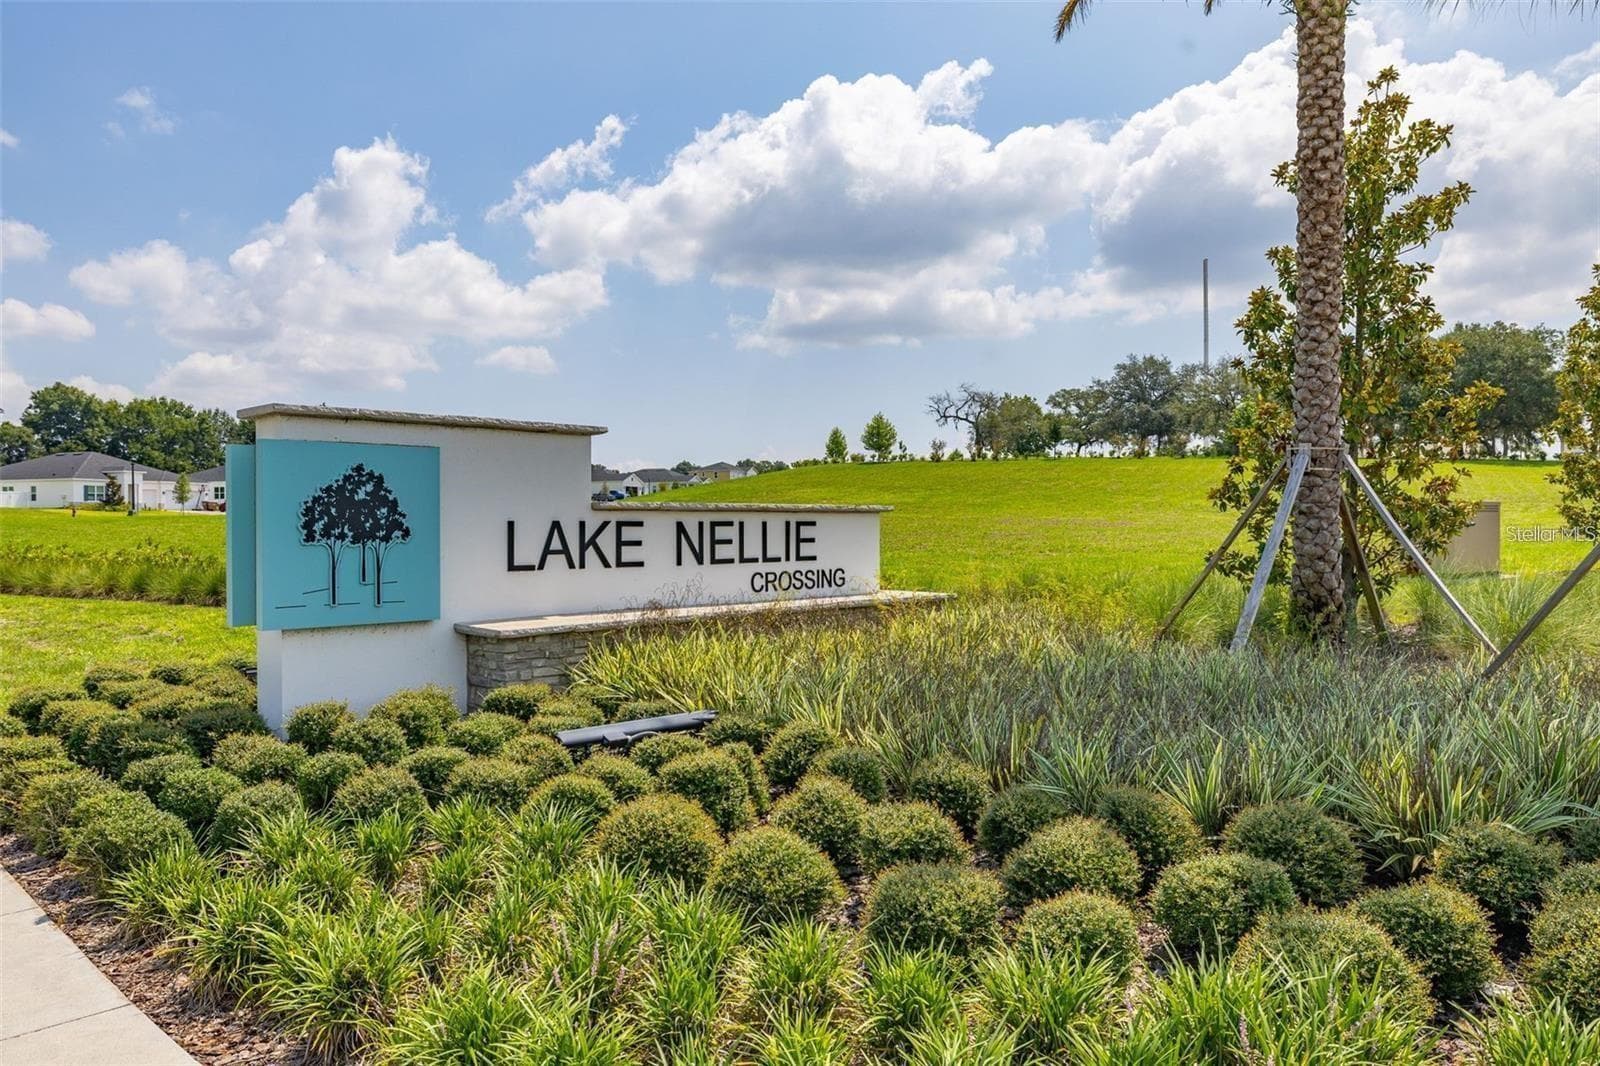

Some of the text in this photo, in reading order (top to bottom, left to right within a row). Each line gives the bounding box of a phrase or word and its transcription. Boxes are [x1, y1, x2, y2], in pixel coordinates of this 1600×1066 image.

[507, 520, 818, 571] LAKE NELLIE
[751, 568, 846, 593] CROSSING
